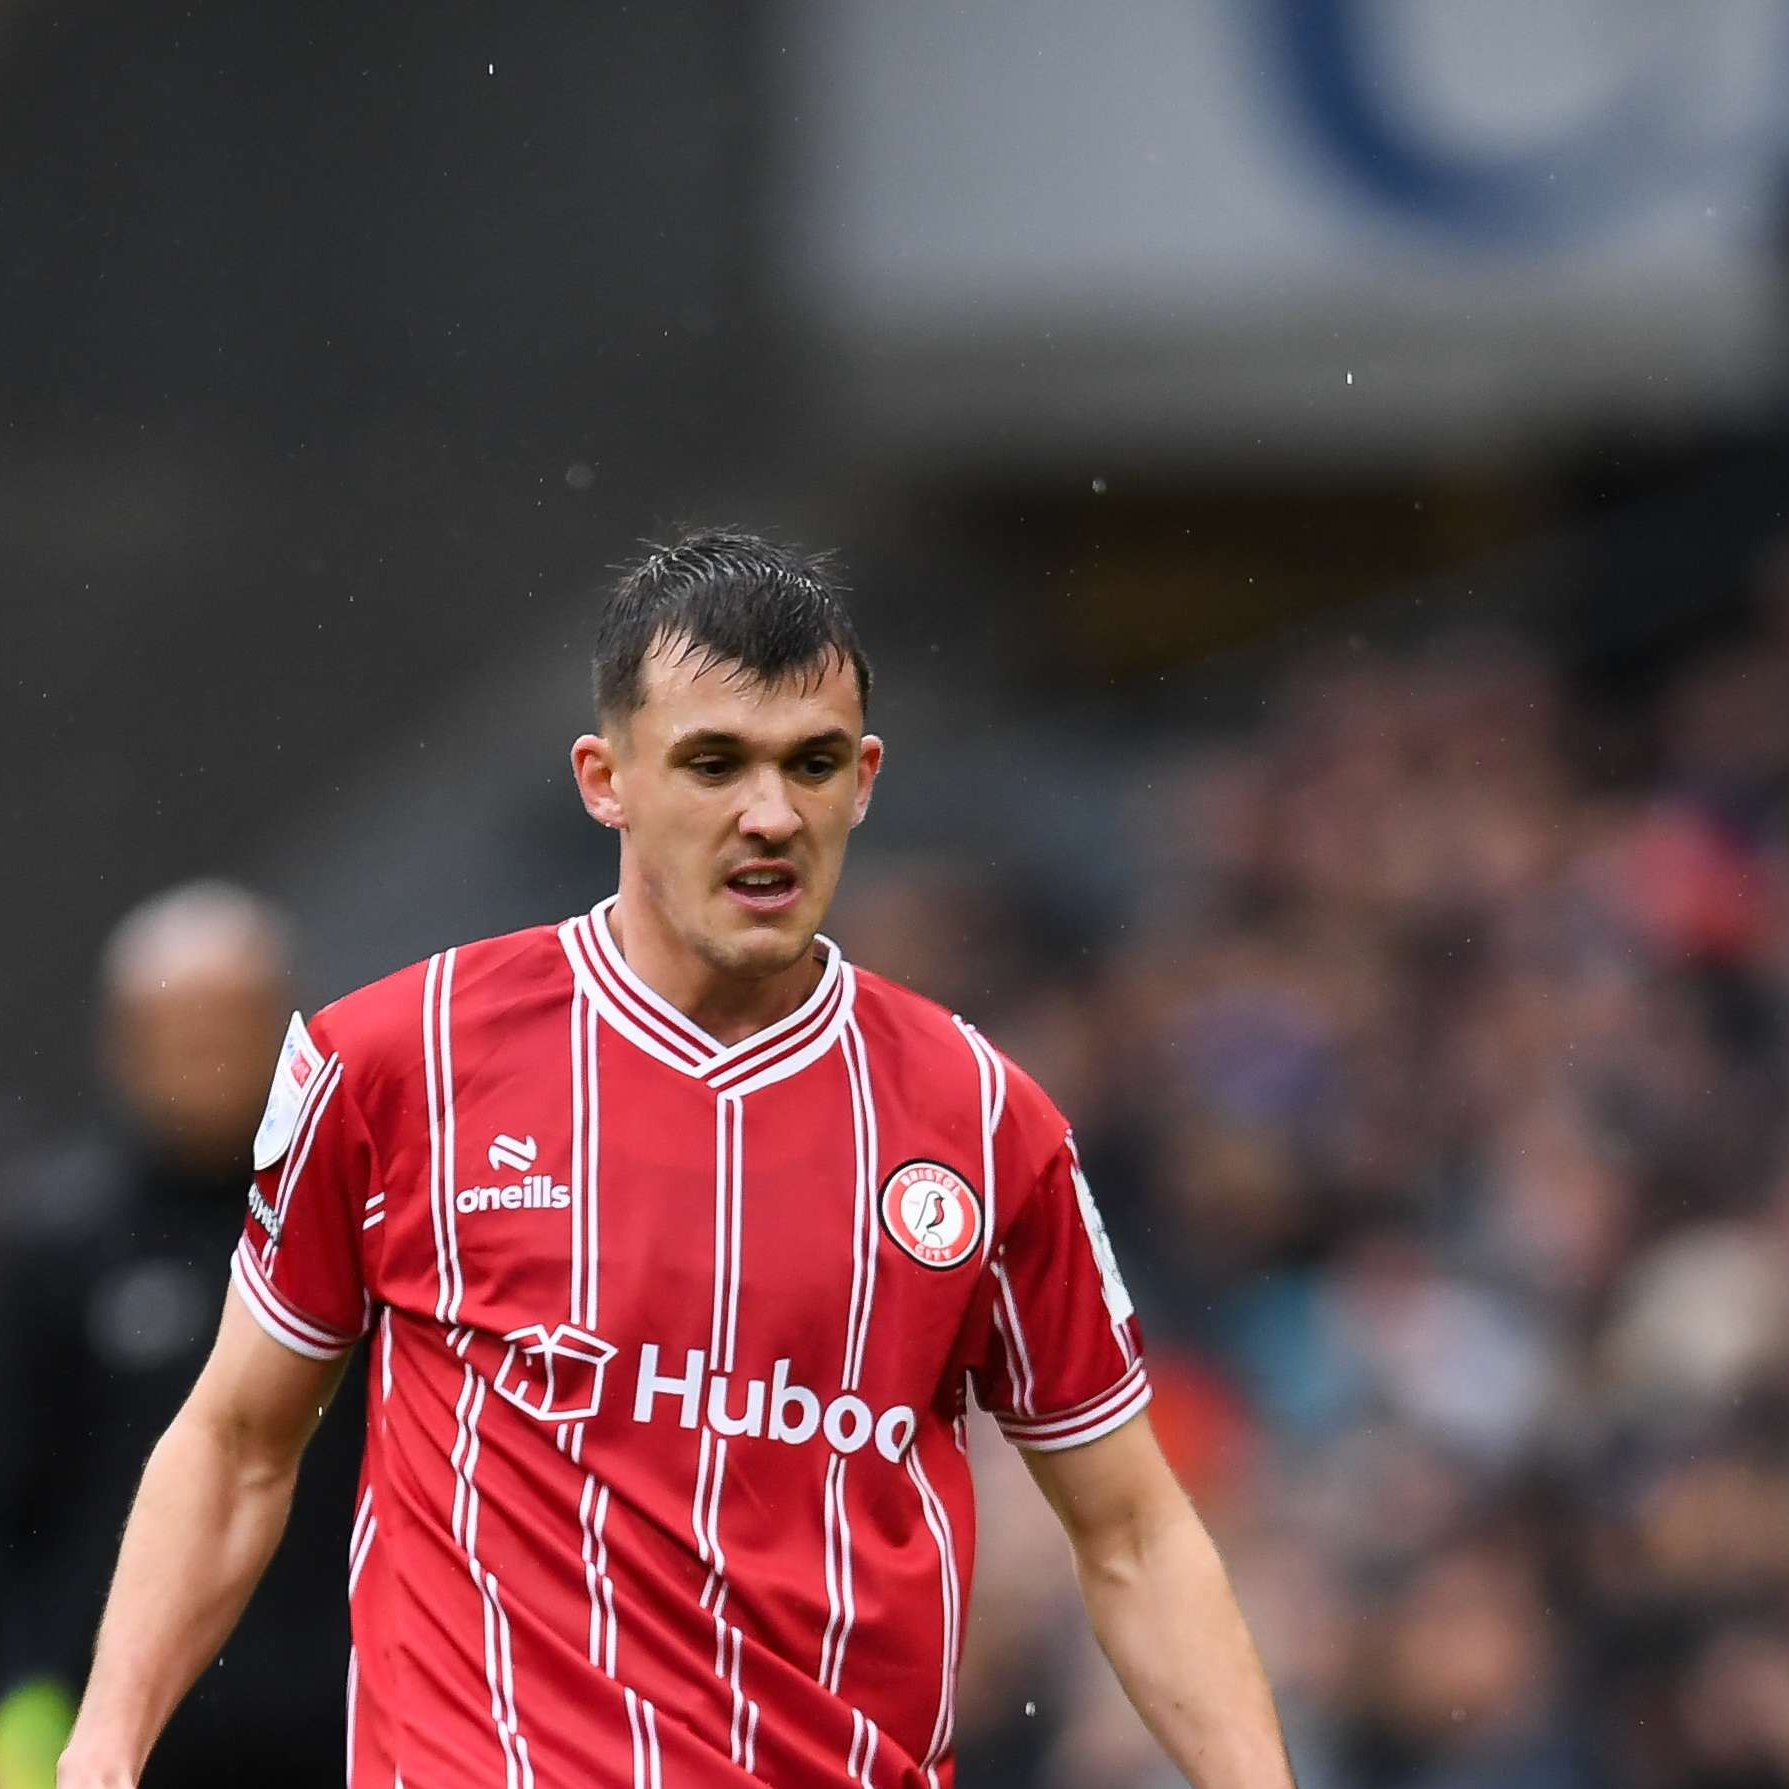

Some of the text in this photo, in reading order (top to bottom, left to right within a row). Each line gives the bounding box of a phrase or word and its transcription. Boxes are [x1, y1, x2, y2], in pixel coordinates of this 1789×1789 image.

[899, 1168, 962, 1197] BRISTOL
[915, 1243, 952, 1260] CITY
[633, 1342, 916, 1463] Huboo
